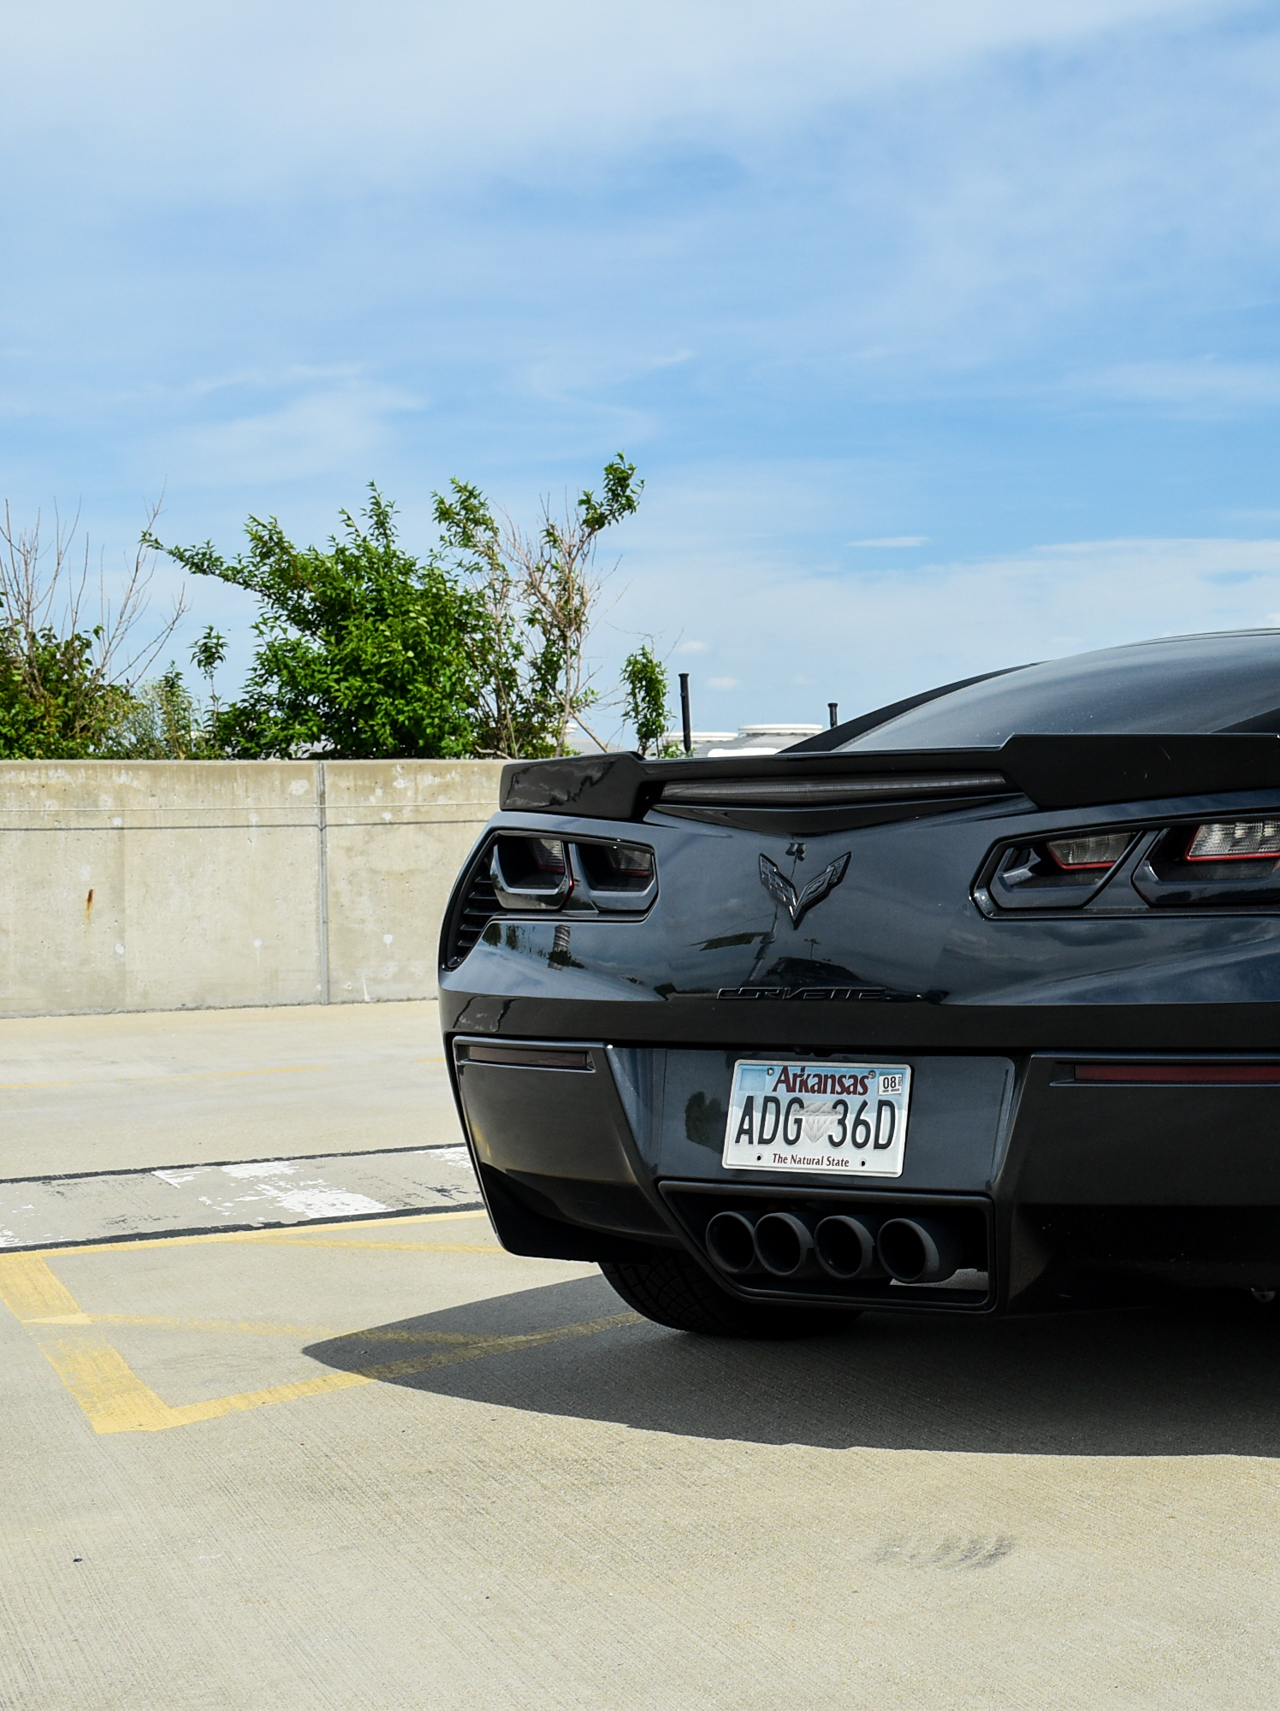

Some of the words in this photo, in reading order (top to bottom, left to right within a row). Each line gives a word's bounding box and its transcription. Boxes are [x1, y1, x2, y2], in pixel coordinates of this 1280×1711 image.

[772, 1066, 869, 1095] Arkansas
[883, 1077, 896, 1089] 08
[735, 1096, 805, 1146] ADG
[828, 1099, 896, 1149] 36D
[772, 1153, 788, 1164] The
[790, 1154, 824, 1166] Natural
[826, 1156, 850, 1167] State
